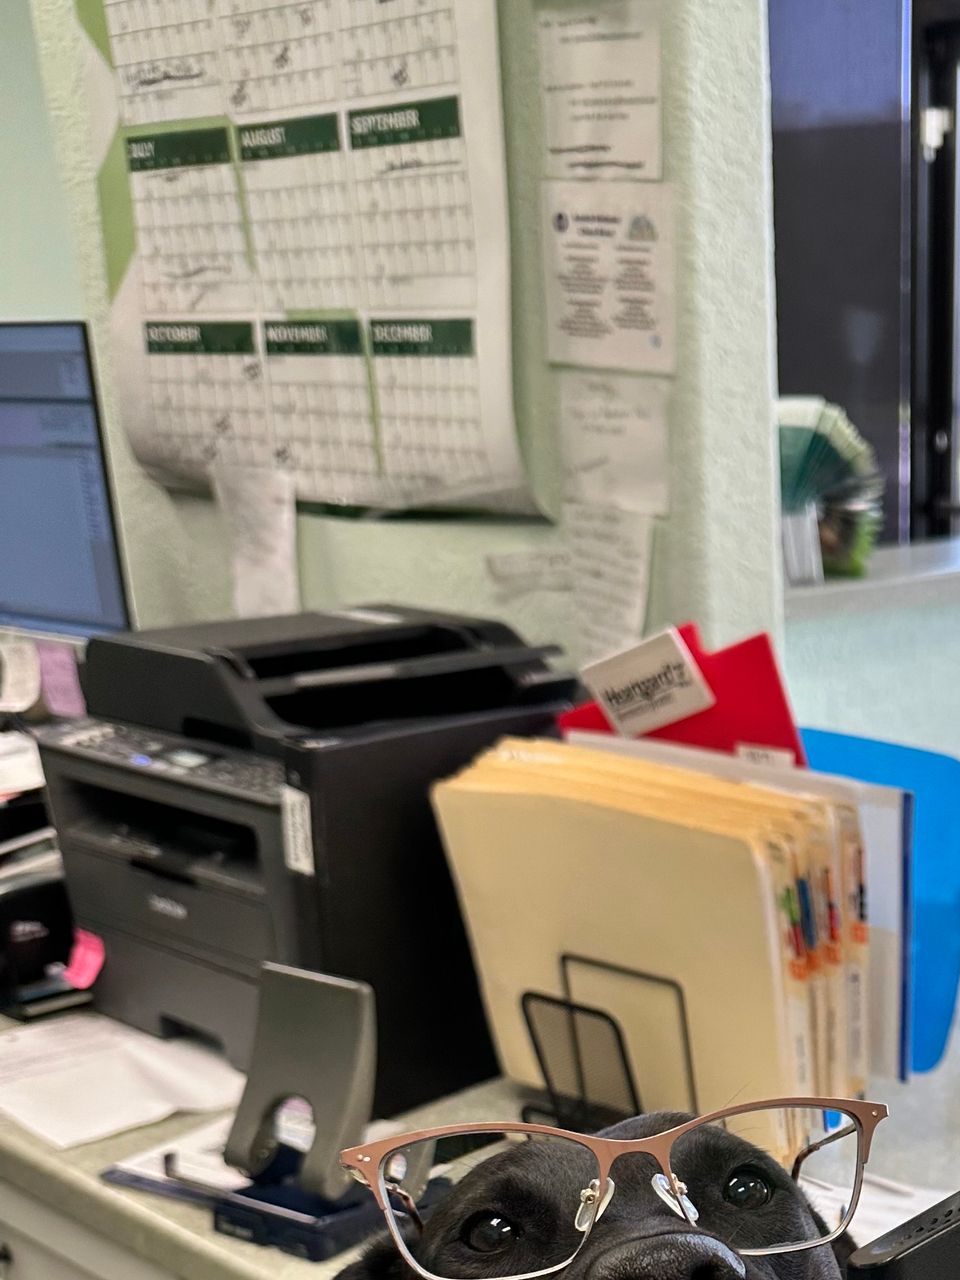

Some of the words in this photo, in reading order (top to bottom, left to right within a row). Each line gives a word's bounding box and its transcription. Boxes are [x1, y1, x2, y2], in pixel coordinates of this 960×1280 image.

[351, 109, 420, 135] SEPTEMBER
[241, 126, 286, 146] AUGUST
[147, 324, 201, 343] OCTOBER
[266, 324, 328, 343] NOVEMBER
[373, 323, 433, 343] DECEMBER
